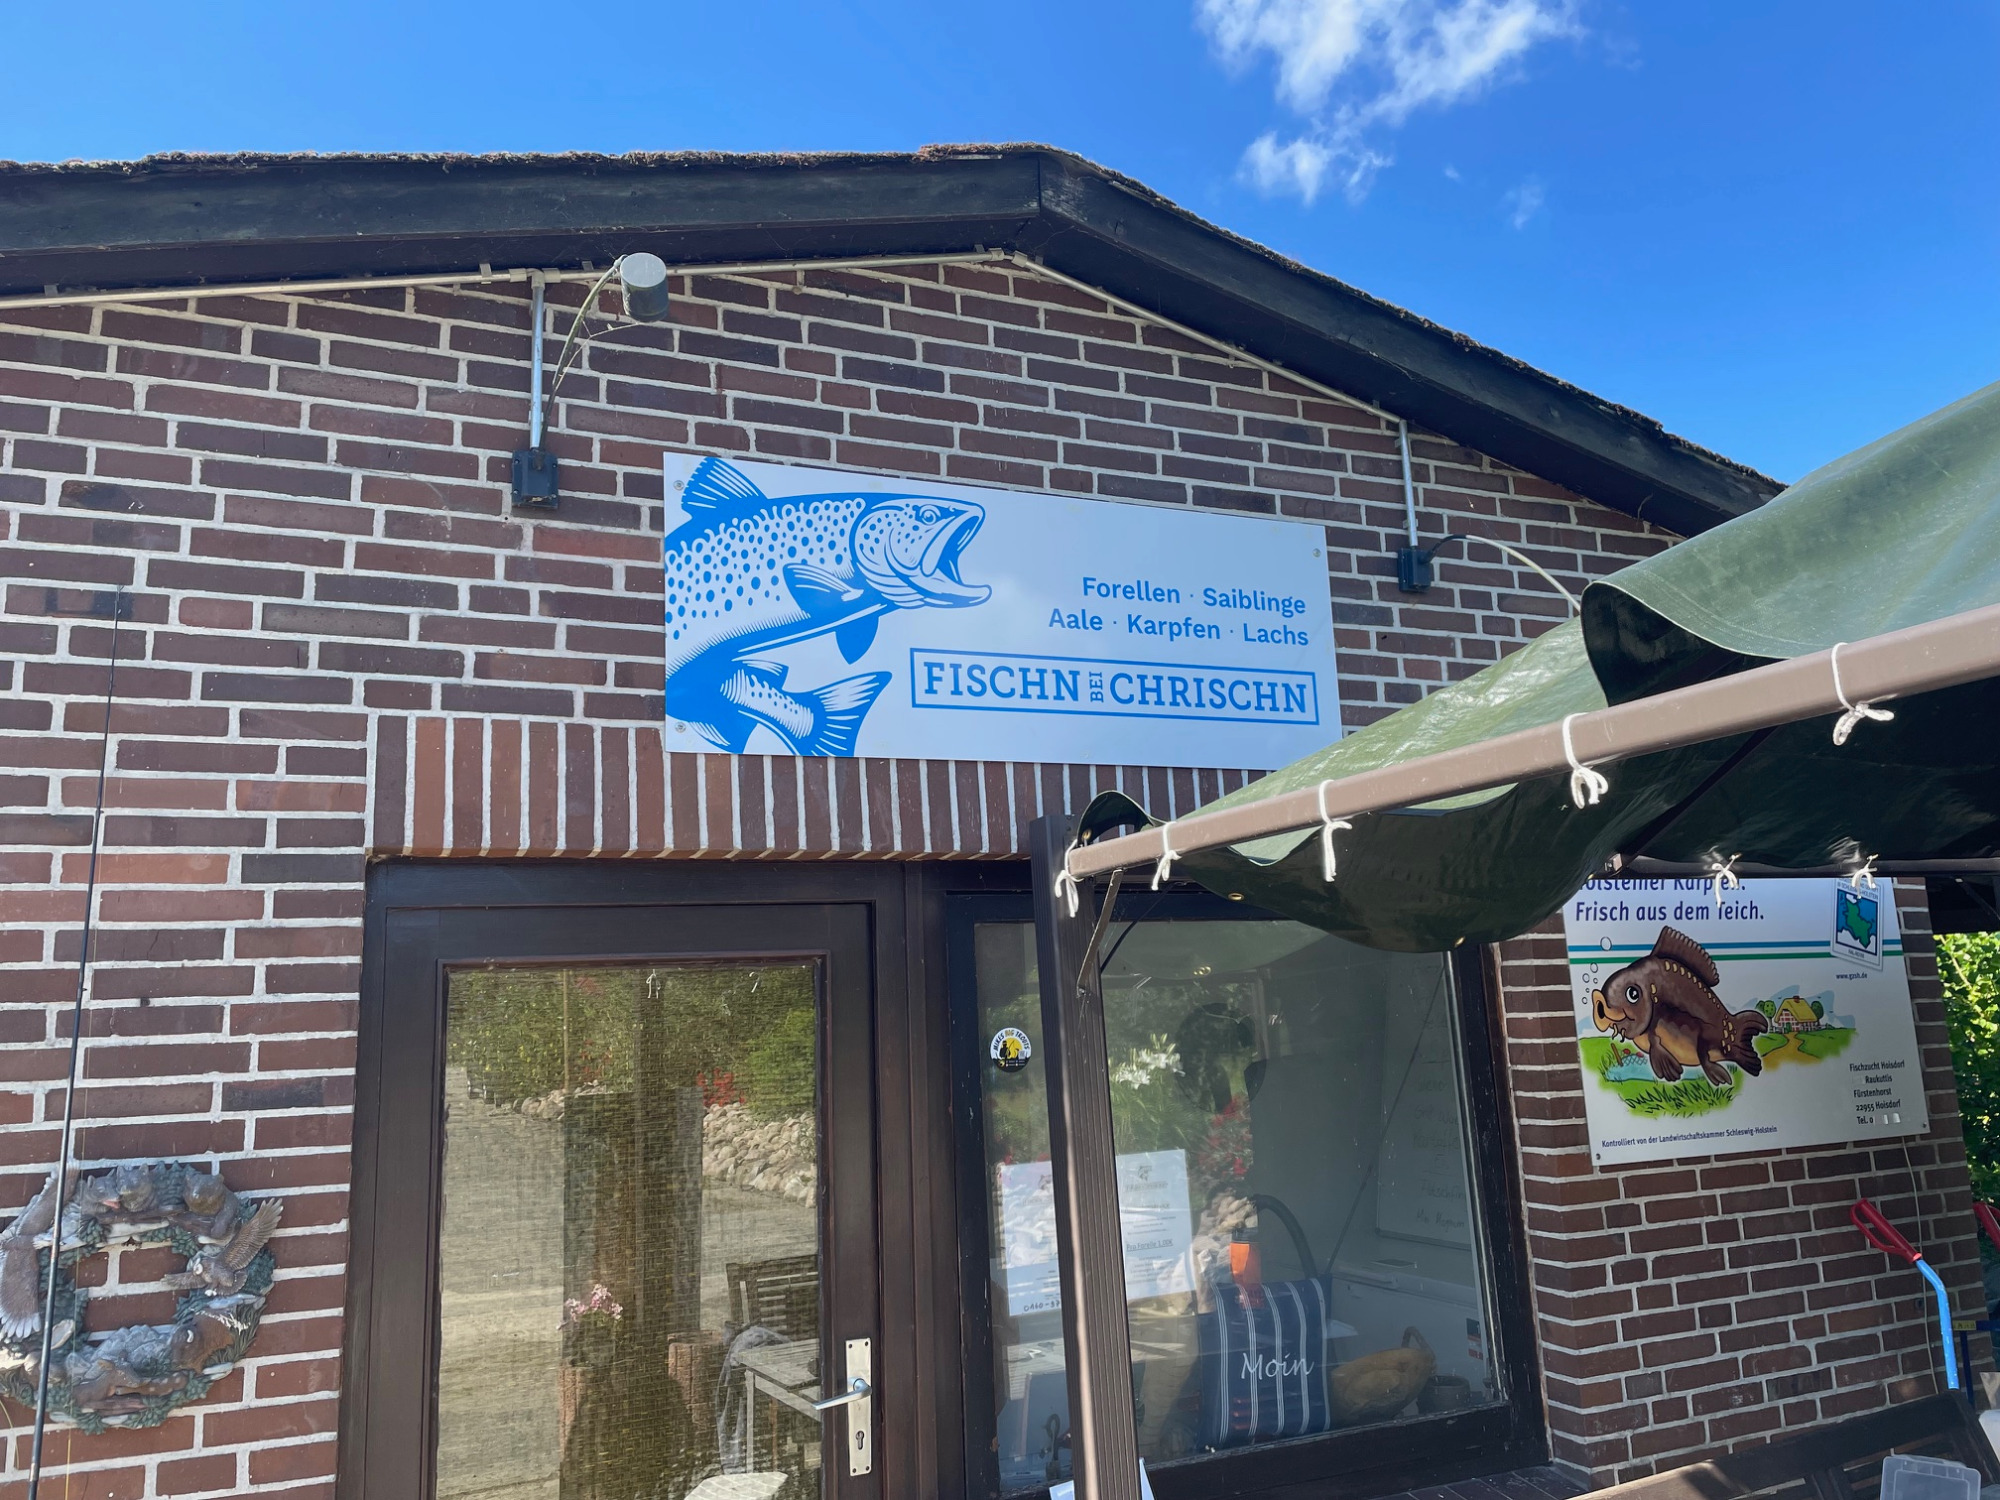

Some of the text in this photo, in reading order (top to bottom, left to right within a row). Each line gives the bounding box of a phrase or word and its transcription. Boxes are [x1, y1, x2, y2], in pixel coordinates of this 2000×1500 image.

[1082, 577, 1306, 618] Forellen Saiblinge
[1048, 608, 1309, 646] Aale Karpfen Lachs
[923, 661, 1307, 714] FISCHN BEI CHRISCHN
[1579, 878, 1665, 891] olsteiner
[1575, 901, 1764, 921] Frisch aus dem Teich.
[1849, 1060, 1905, 1072] Fischzucht Hoisdorf
[1853, 1088, 1892, 1098] Fürstenhorst
[1856, 1099, 1901, 1112] 22955 Hoisdorf
[1857, 1116, 1869, 1124] Tel.
[1601, 1138, 1636, 1148] Kontrolliert
[1648, 1136, 1658, 1144] der
[1659, 1130, 1725, 1143] Landwirtschaftskammer
[1726, 1126, 1778, 1137] Schleswig-Holstein
[1241, 1352, 1315, 1380] Moin
